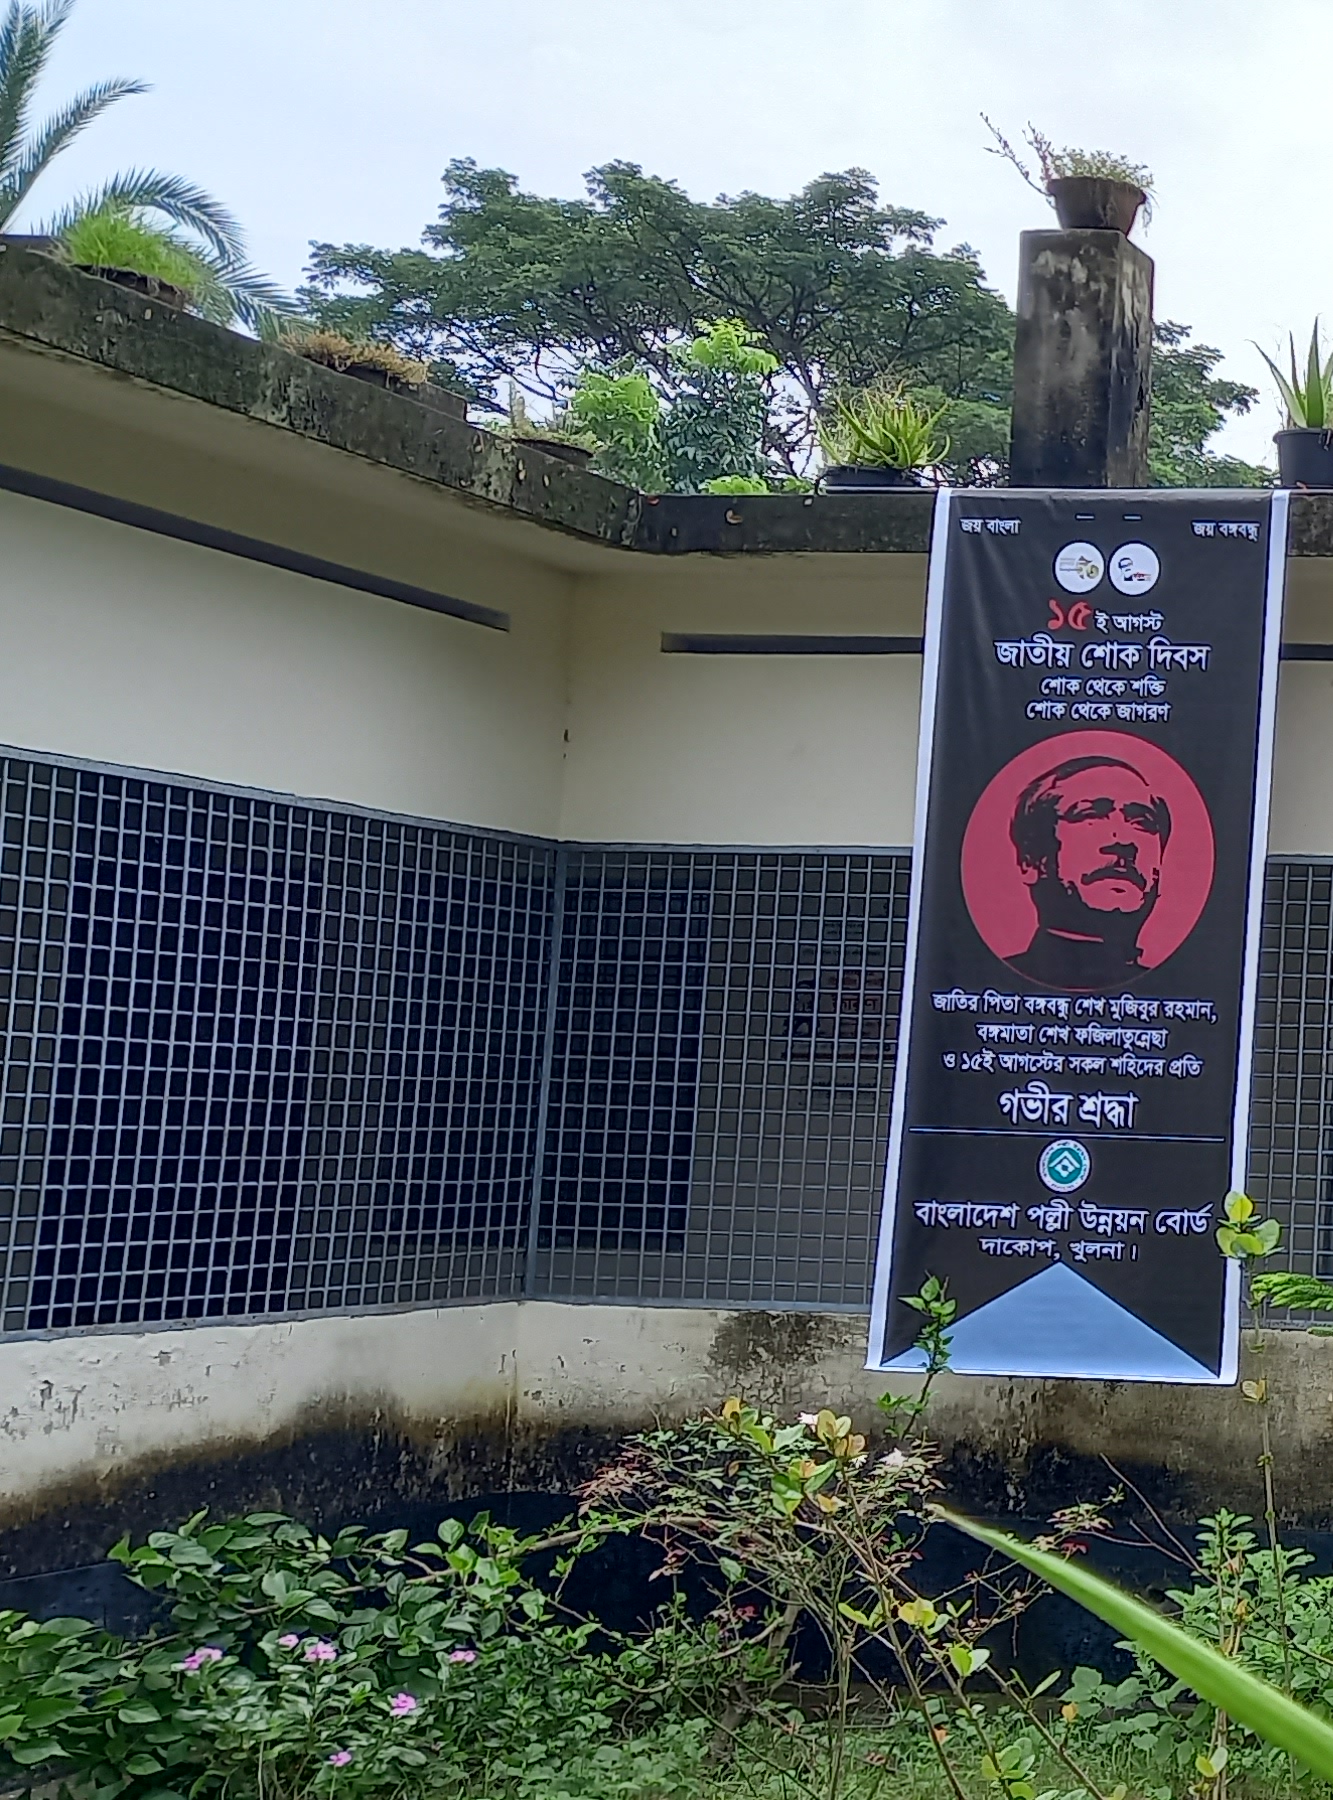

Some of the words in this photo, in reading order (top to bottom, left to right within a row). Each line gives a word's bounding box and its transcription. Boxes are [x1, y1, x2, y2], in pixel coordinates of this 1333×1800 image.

[960, 518, 984, 534] জয়
[985, 518, 1021, 535] বাংলা
[1192, 522, 1216, 537] জয়
[1218, 522, 1260, 542] বঙ্গবন্ধু
[1047, 599, 1092, 631] ১৫
[1112, 610, 1164, 632] আগস্ট
[994, 633, 1075, 668] জাতীয়
[1081, 641, 1143, 669] শোক
[1147, 636, 1211, 671] দিবস
[1041, 676, 1082, 695] শোক
[1085, 677, 1127, 696] থেকে
[1131, 674, 1166, 697] শক্তি
[1026, 700, 1068, 719] শোক
[1071, 701, 1113, 720] থেকে
[1116, 703, 1171, 721] জাগরণ
[932, 990, 981, 1013] জাতির
[983, 991, 1021, 1015] পিতা
[1024, 995, 1070, 1020] বঙ্গবন্ধু
[1074, 997, 1106, 1017] শেখ
[1109, 994, 1160, 1021] মুজিবুর
[1163, 1000, 1218, 1024] রহমান,
[976, 1023, 1035, 1044] বঙ্গমাতা
[1039, 1025, 1071, 1045] শেখ
[943, 1052, 956, 1069] ও
[961, 1048, 996, 1073] ১৫ই
[999, 1051, 1066, 1073] আগস্টের
[1068, 1056, 1107, 1075] সকল
[1110, 1054, 1166, 1078] শহিদের
[1168, 1054, 1203, 1078] প্রতি
[999, 1080, 1073, 1125] গভীর
[1078, 1092, 1140, 1129] শ্রদ্ধা
[914, 1200, 1020, 1229] বাংলাদেশ
[1026, 1198, 1074, 1232] পল্লী
[1078, 1200, 1149, 1237] উন্নয়ন
[1155, 1202, 1213, 1235] বোর্ড
[979, 1236, 1061, 1260] দাকোপ,
